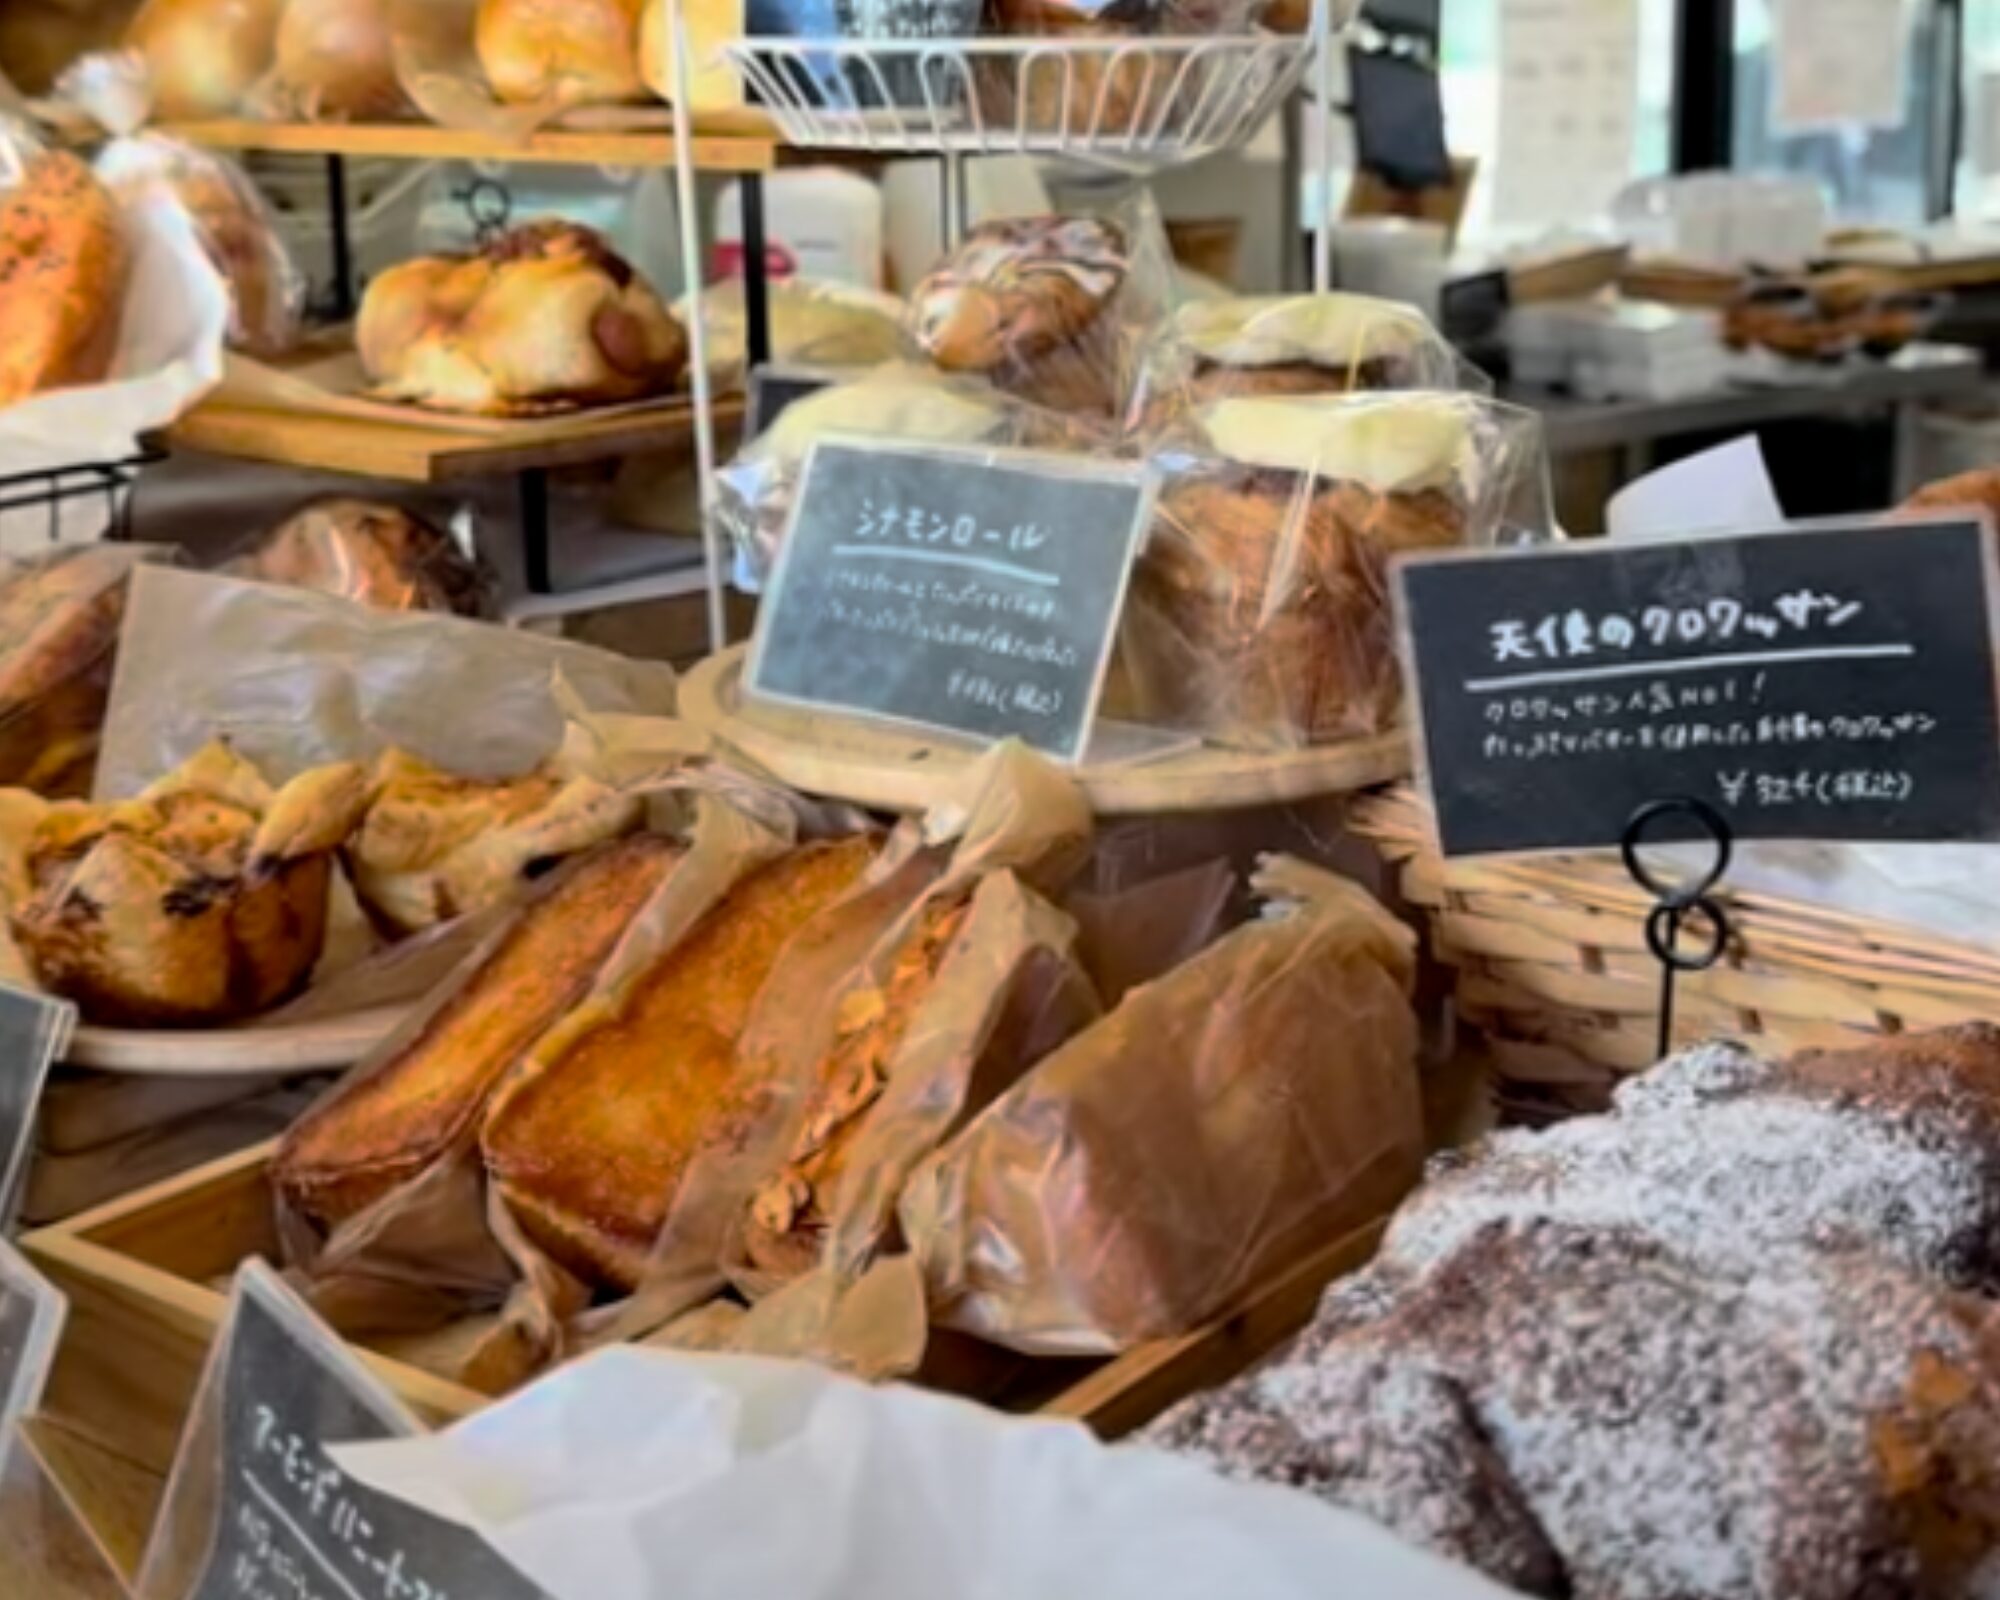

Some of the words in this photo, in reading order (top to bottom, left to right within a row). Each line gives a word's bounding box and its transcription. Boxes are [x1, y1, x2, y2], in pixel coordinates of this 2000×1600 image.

[856, 498, 1051, 550] シナモンロール
[1489, 588, 1862, 661] 天使のクロワッサン
